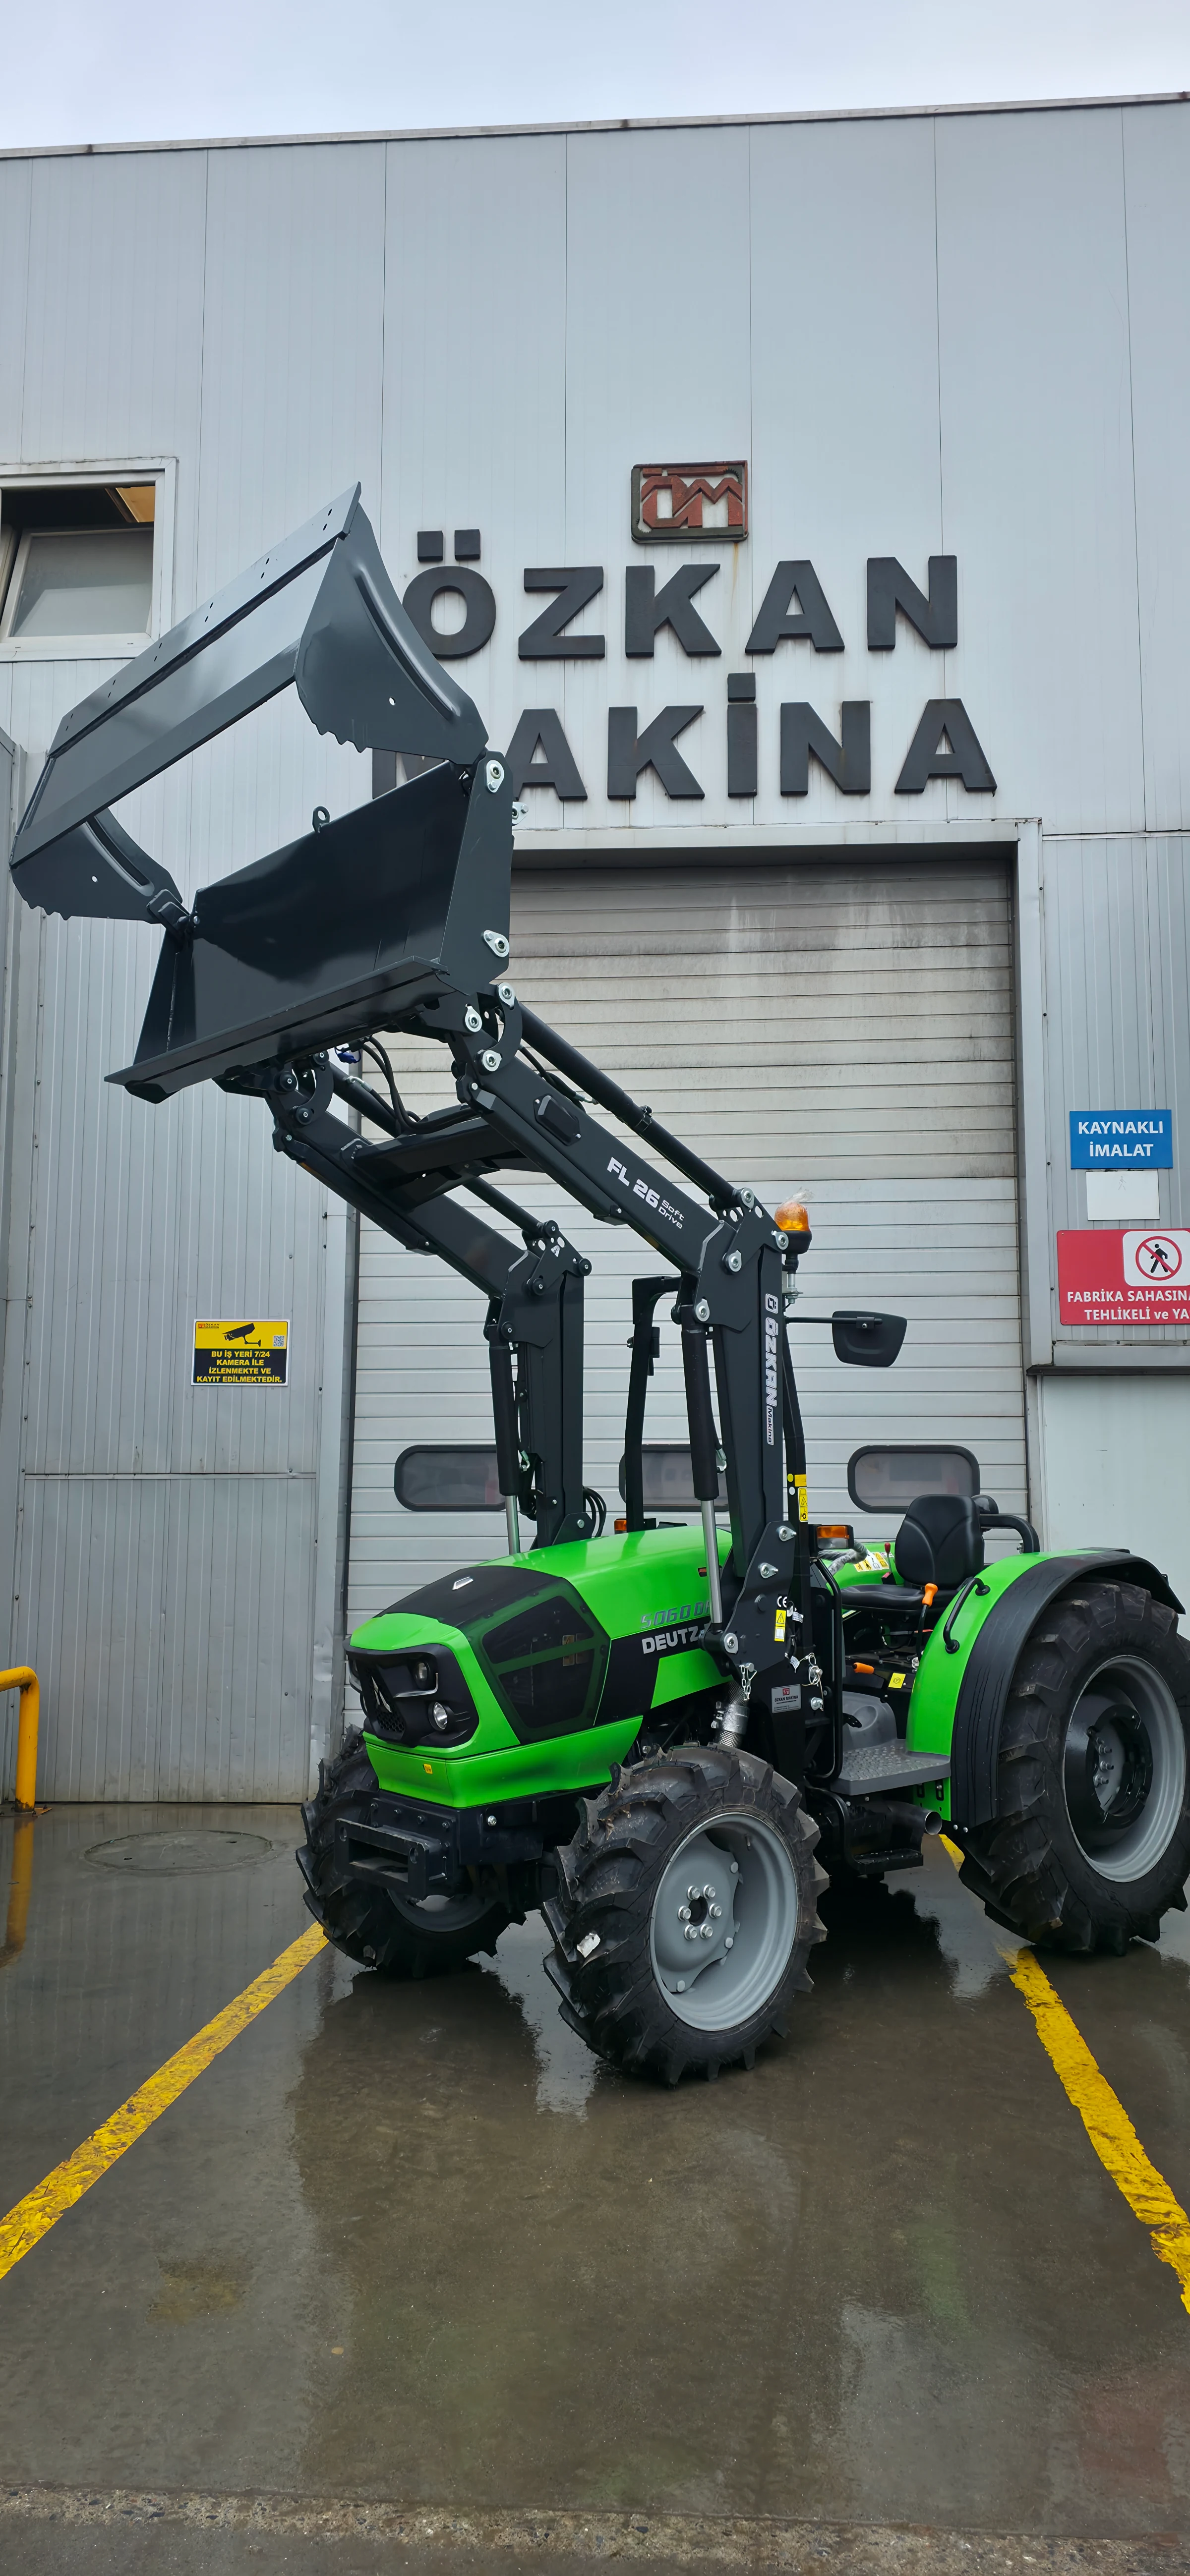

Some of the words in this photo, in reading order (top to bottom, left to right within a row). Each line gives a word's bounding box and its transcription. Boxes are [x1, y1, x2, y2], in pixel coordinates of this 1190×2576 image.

[402, 529, 958, 660] ÖZKAN
[1078, 1121, 1163, 1134] KAYNAKLI
[1090, 1142, 1154, 1156] İMALAT
[607, 1157, 630, 1187] FL
[633, 1179, 660, 1208] 26
[658, 1206, 683, 1229] Drive
[661, 1200, 684, 1221] Soft
[1068, 1289, 1124, 1302] FABRİKA
[1128, 1290, 1190, 1302] SAHASIN
[1084, 1307, 1150, 1320] TEHLİKELİ
[1154, 1311, 1169, 1319] ve
[1173, 1309, 1190, 1319] YA
[766, 1317, 778, 1407] ÖZKAN
[642, 1623, 711, 1654] DEUTZ
